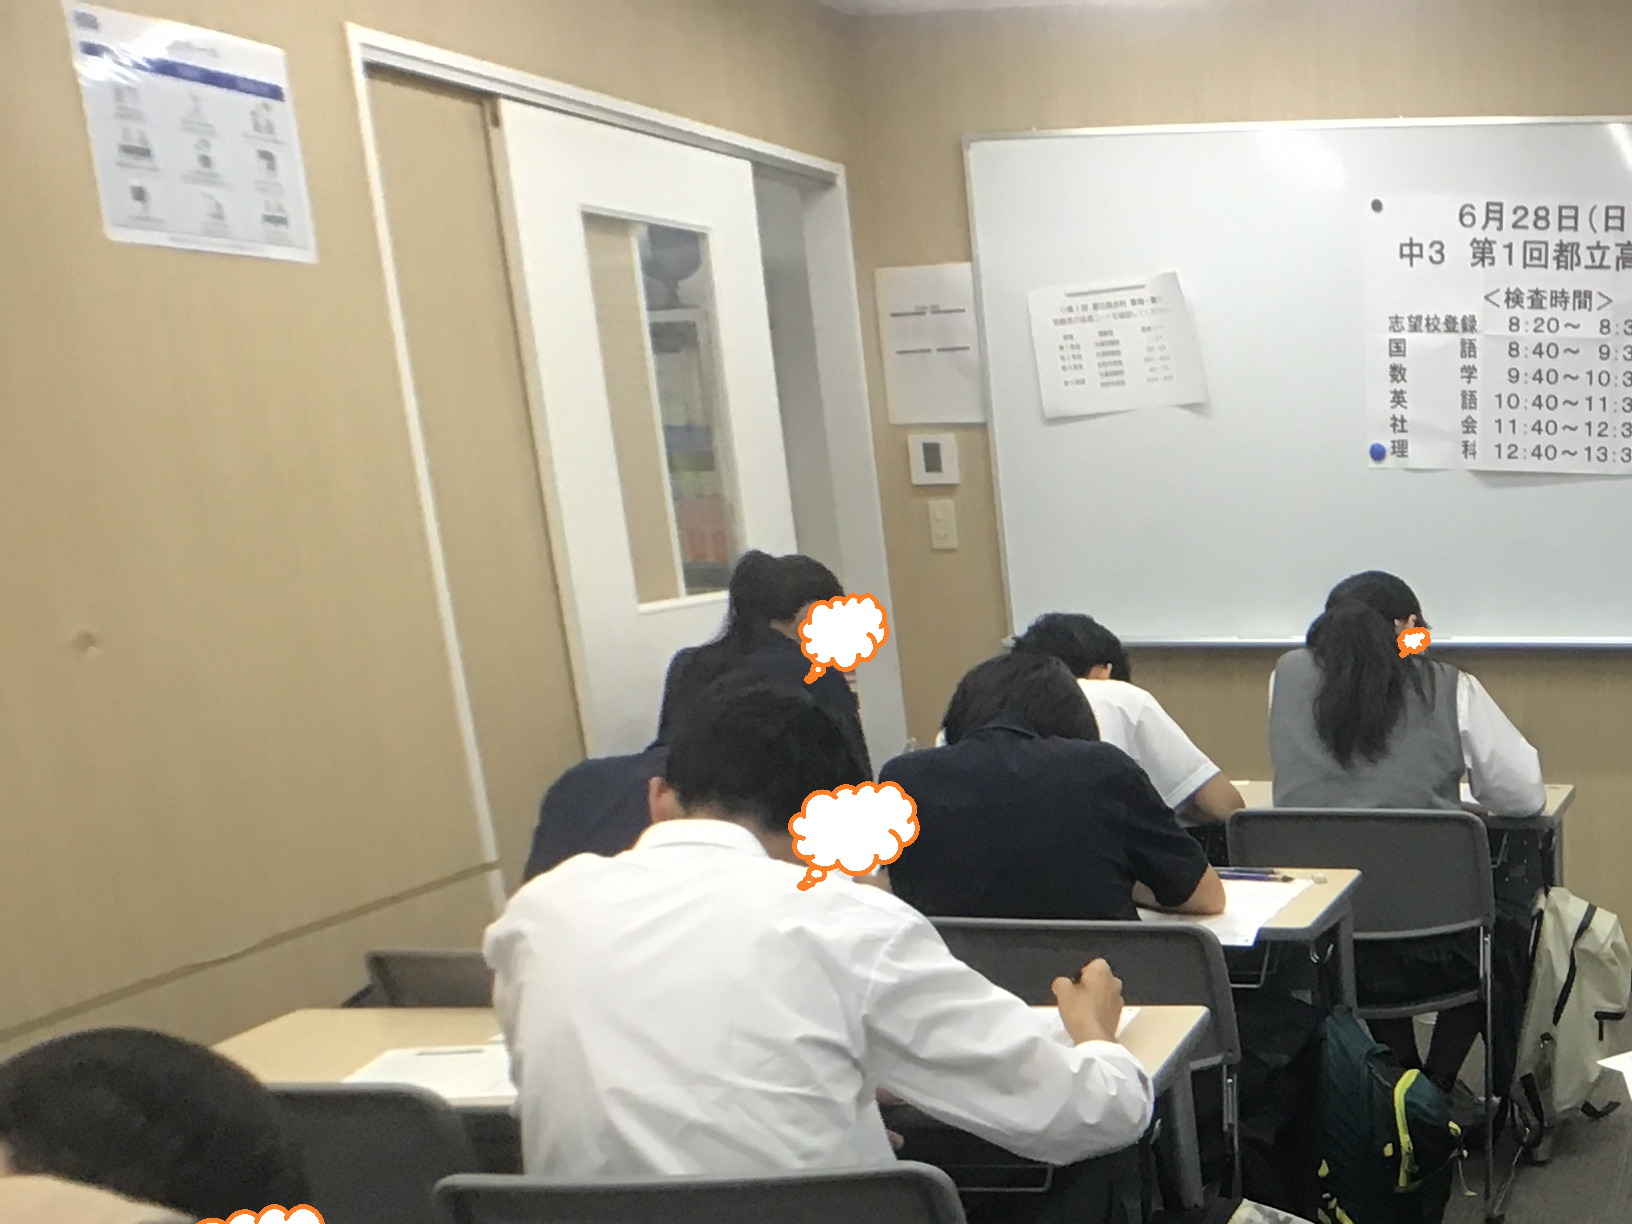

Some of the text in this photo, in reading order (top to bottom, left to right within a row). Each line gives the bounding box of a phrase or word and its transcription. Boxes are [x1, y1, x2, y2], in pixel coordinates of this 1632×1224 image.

[1399, 236, 1445, 268] 中3
[1388, 314, 1478, 334] 志望校登録
